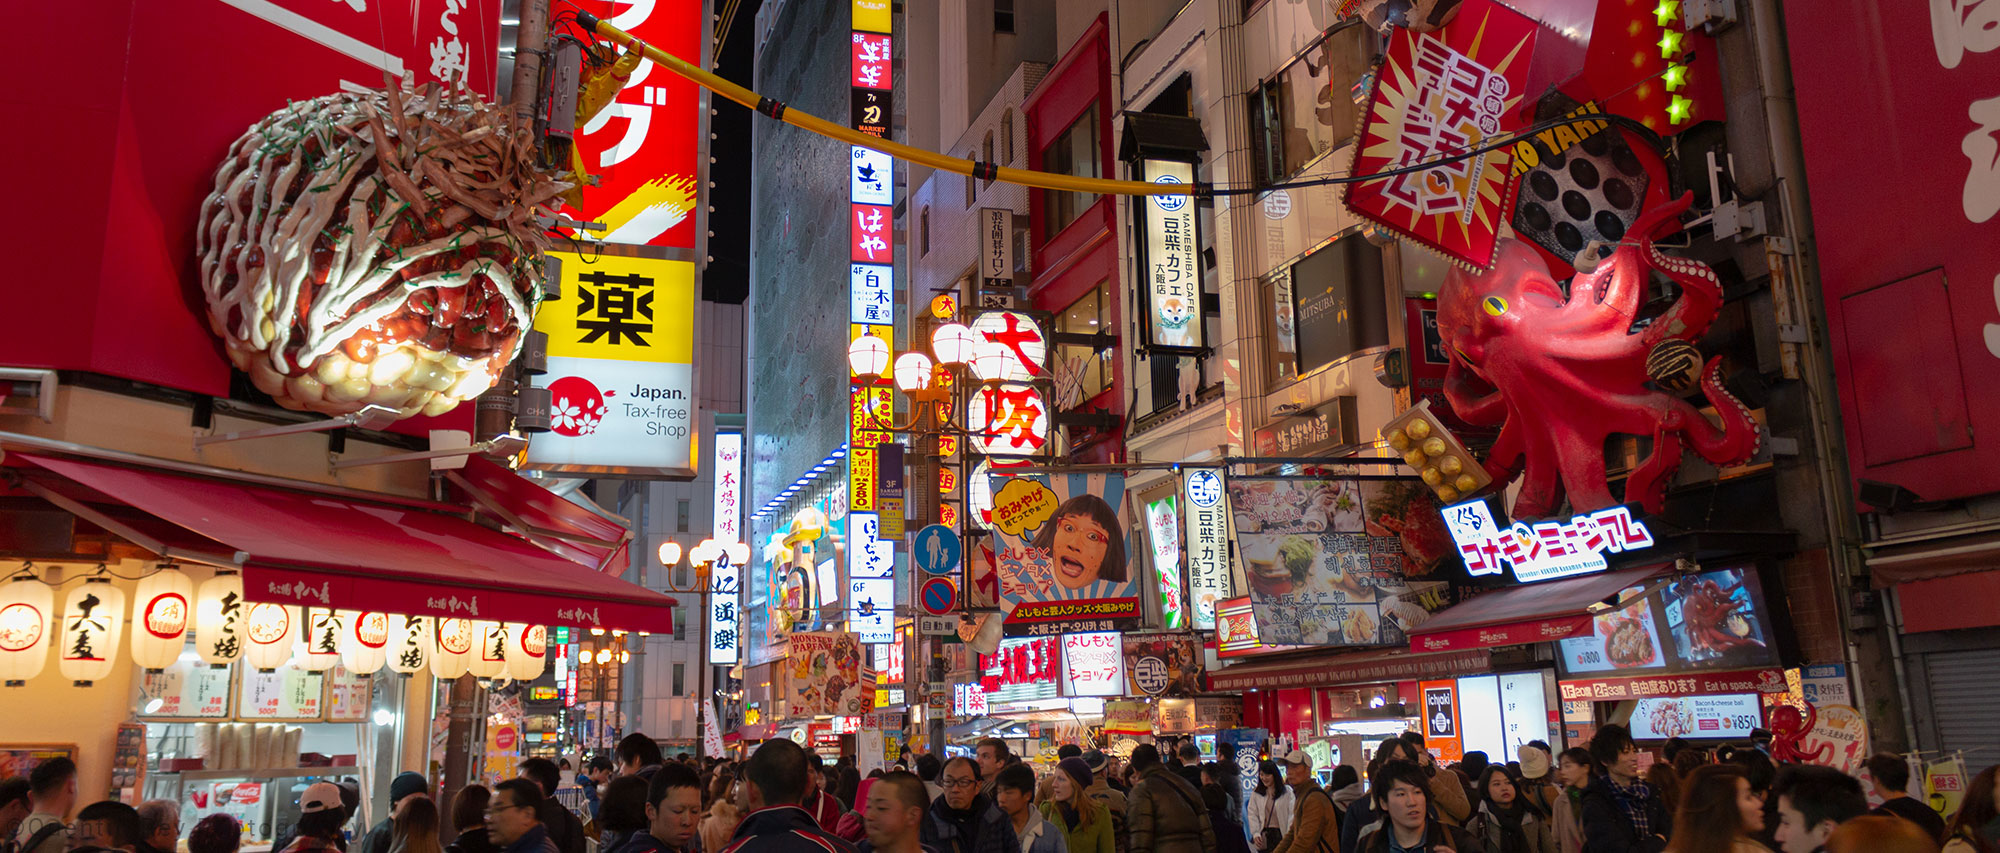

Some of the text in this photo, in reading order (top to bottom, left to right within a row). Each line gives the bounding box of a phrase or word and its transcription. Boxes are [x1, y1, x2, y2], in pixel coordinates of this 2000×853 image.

[853, 34, 864, 44] 8F
[867, 93, 876, 102] 7F
[859, 124, 885, 133] MARKET
[1384, 35, 1451, 206] ミュージアム
[854, 150, 866, 159] 6F
[857, 208, 887, 260] はや
[1164, 217, 1182, 297] 豆柴カフェ
[1183, 212, 1195, 313] MAMESHIBA CAFE
[853, 267, 863, 275] 4F
[1155, 263, 1166, 295] 大阪店
[864, 270, 889, 320] 白木屋
[577, 271, 654, 347] 薬
[939, 298, 952, 312] 大
[1300, 295, 1335, 321] MITSUBA
[981, 312, 1047, 450] 大阪
[630, 384, 687, 401] Japan.
[527, 407, 545, 416] CH4
[623, 403, 687, 419] Tax-free
[646, 422, 687, 439] Shop
[886, 480, 896, 488] 3F
[855, 482, 867, 506] 280
[720, 471, 735, 535] 本場の味
[998, 487, 1043, 520] おみやげ
[1216, 505, 1226, 570] MAMESHIBA
[999, 546, 1050, 561] よしもと
[1199, 510, 1216, 588] 豆柴カフェ
[1001, 562, 1052, 579] エンタメ
[1192, 557, 1201, 588] 大阪店
[853, 583, 865, 592] 6F
[1002, 579, 1053, 596] ショップ
[213, 591, 242, 659] たこ焼
[923, 621, 953, 631] 自動車
[790, 634, 833, 644] MONSTER
[1067, 635, 1115, 648] よしもと
[1123, 635, 1160, 643] MAMESHIBA
[1162, 633, 1179, 642] CAFE
[1069, 650, 1117, 666] エンタメ
[1068, 666, 1118, 682] ショップ
[1630, 679, 1696, 695] 自由席あります
[1704, 681, 1719, 691] Eat
[1721, 680, 1728, 691] in
[1730, 679, 1755, 692] space.
[1820, 684, 1844, 695] 支付宝
[969, 687, 985, 710] 薬
[259, 707, 277, 715] 500円
[1732, 715, 1757, 729] ¥850
[1237, 748, 1260, 758] COFFEE
